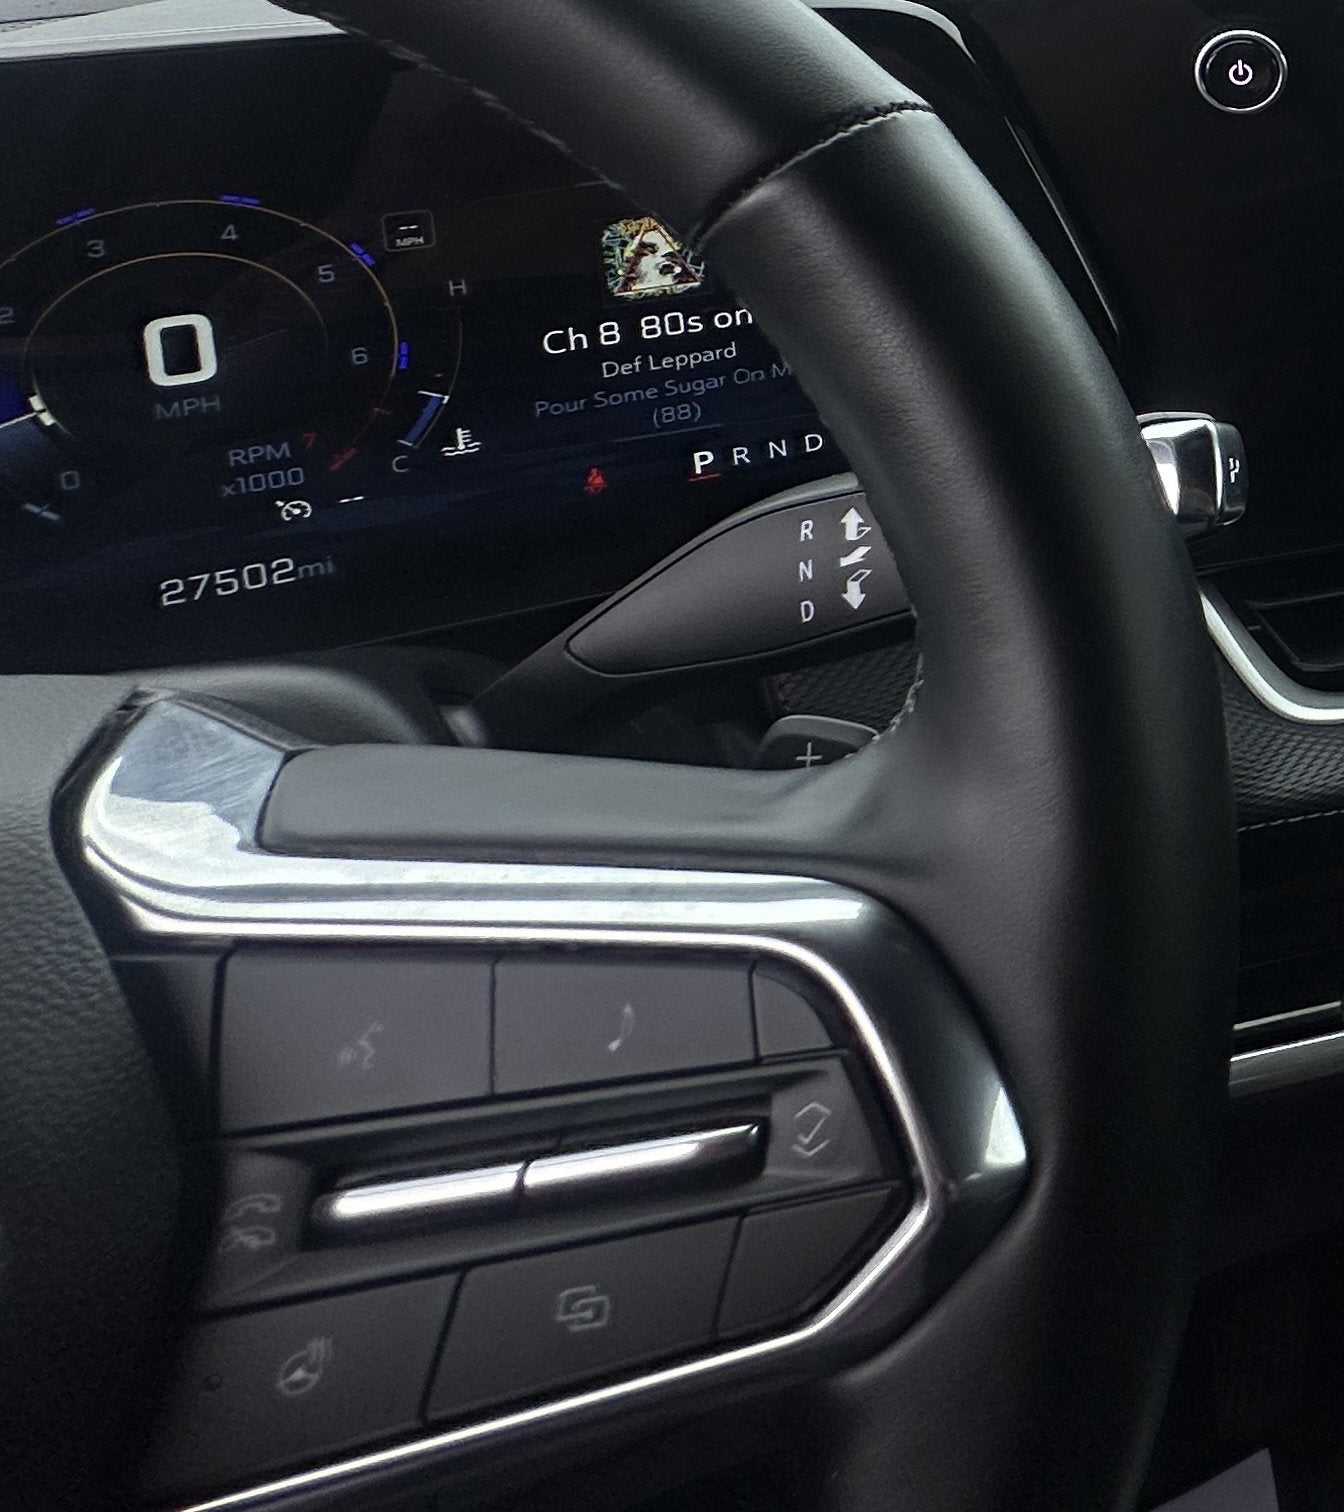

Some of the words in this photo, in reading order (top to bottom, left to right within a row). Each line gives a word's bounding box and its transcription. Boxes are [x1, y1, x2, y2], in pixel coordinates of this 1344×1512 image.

[219, 223, 239, 241] 4
[86, 239, 105, 258] 3
[317, 263, 336, 283] 5
[448, 278, 467, 297] H
[542, 326, 588, 355] Ch
[599, 320, 621, 346] 8
[640, 311, 704, 340] 80s
[713, 308, 753, 329] on
[143, 313, 218, 387] 0
[350, 346, 369, 366] 6
[601, 354, 642, 379] Def
[648, 341, 737, 372] Leppard
[535, 398, 586, 417] Pour
[593, 386, 658, 409] Some
[663, 375, 726, 396] Sugar
[733, 367, 766, 386] On
[155, 394, 222, 421] MPH
[652, 401, 702, 428] (88)
[228, 441, 293, 467] RPM
[391, 454, 411, 473] C
[693, 450, 715, 475] P
[732, 446, 751, 466] R
[768, 439, 788, 458] N
[804, 433, 825, 453] D
[221, 466, 305, 498] x1000
[800, 519, 814, 542] R
[799, 559, 814, 582] N
[800, 600, 815, 623] D
